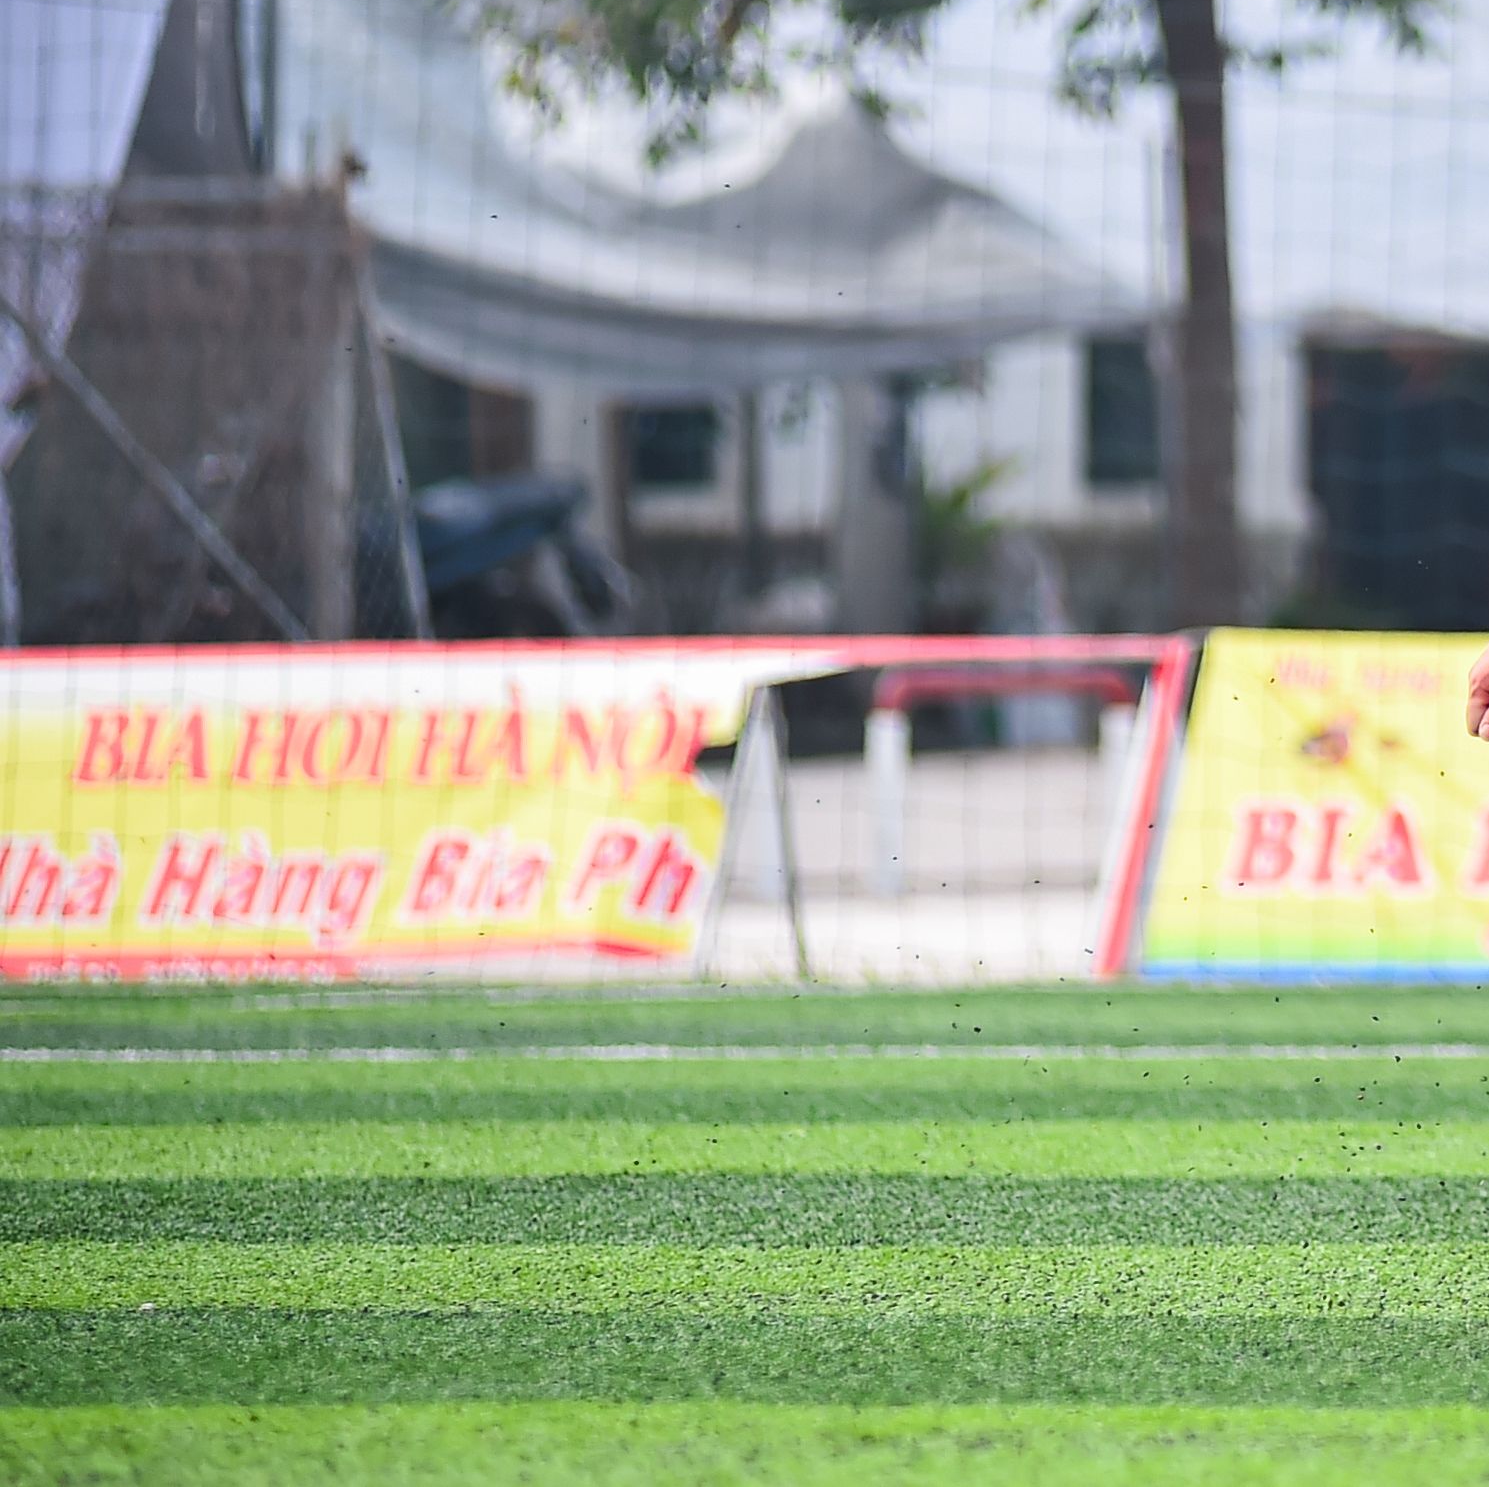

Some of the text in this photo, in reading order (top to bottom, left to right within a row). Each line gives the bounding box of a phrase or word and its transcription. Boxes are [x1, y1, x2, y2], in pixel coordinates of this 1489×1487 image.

[71, 705, 208, 783] BIA
[413, 679, 529, 783] HÀ
[149, 833, 380, 937] Hàng
[1234, 805, 1424, 885] BIA
